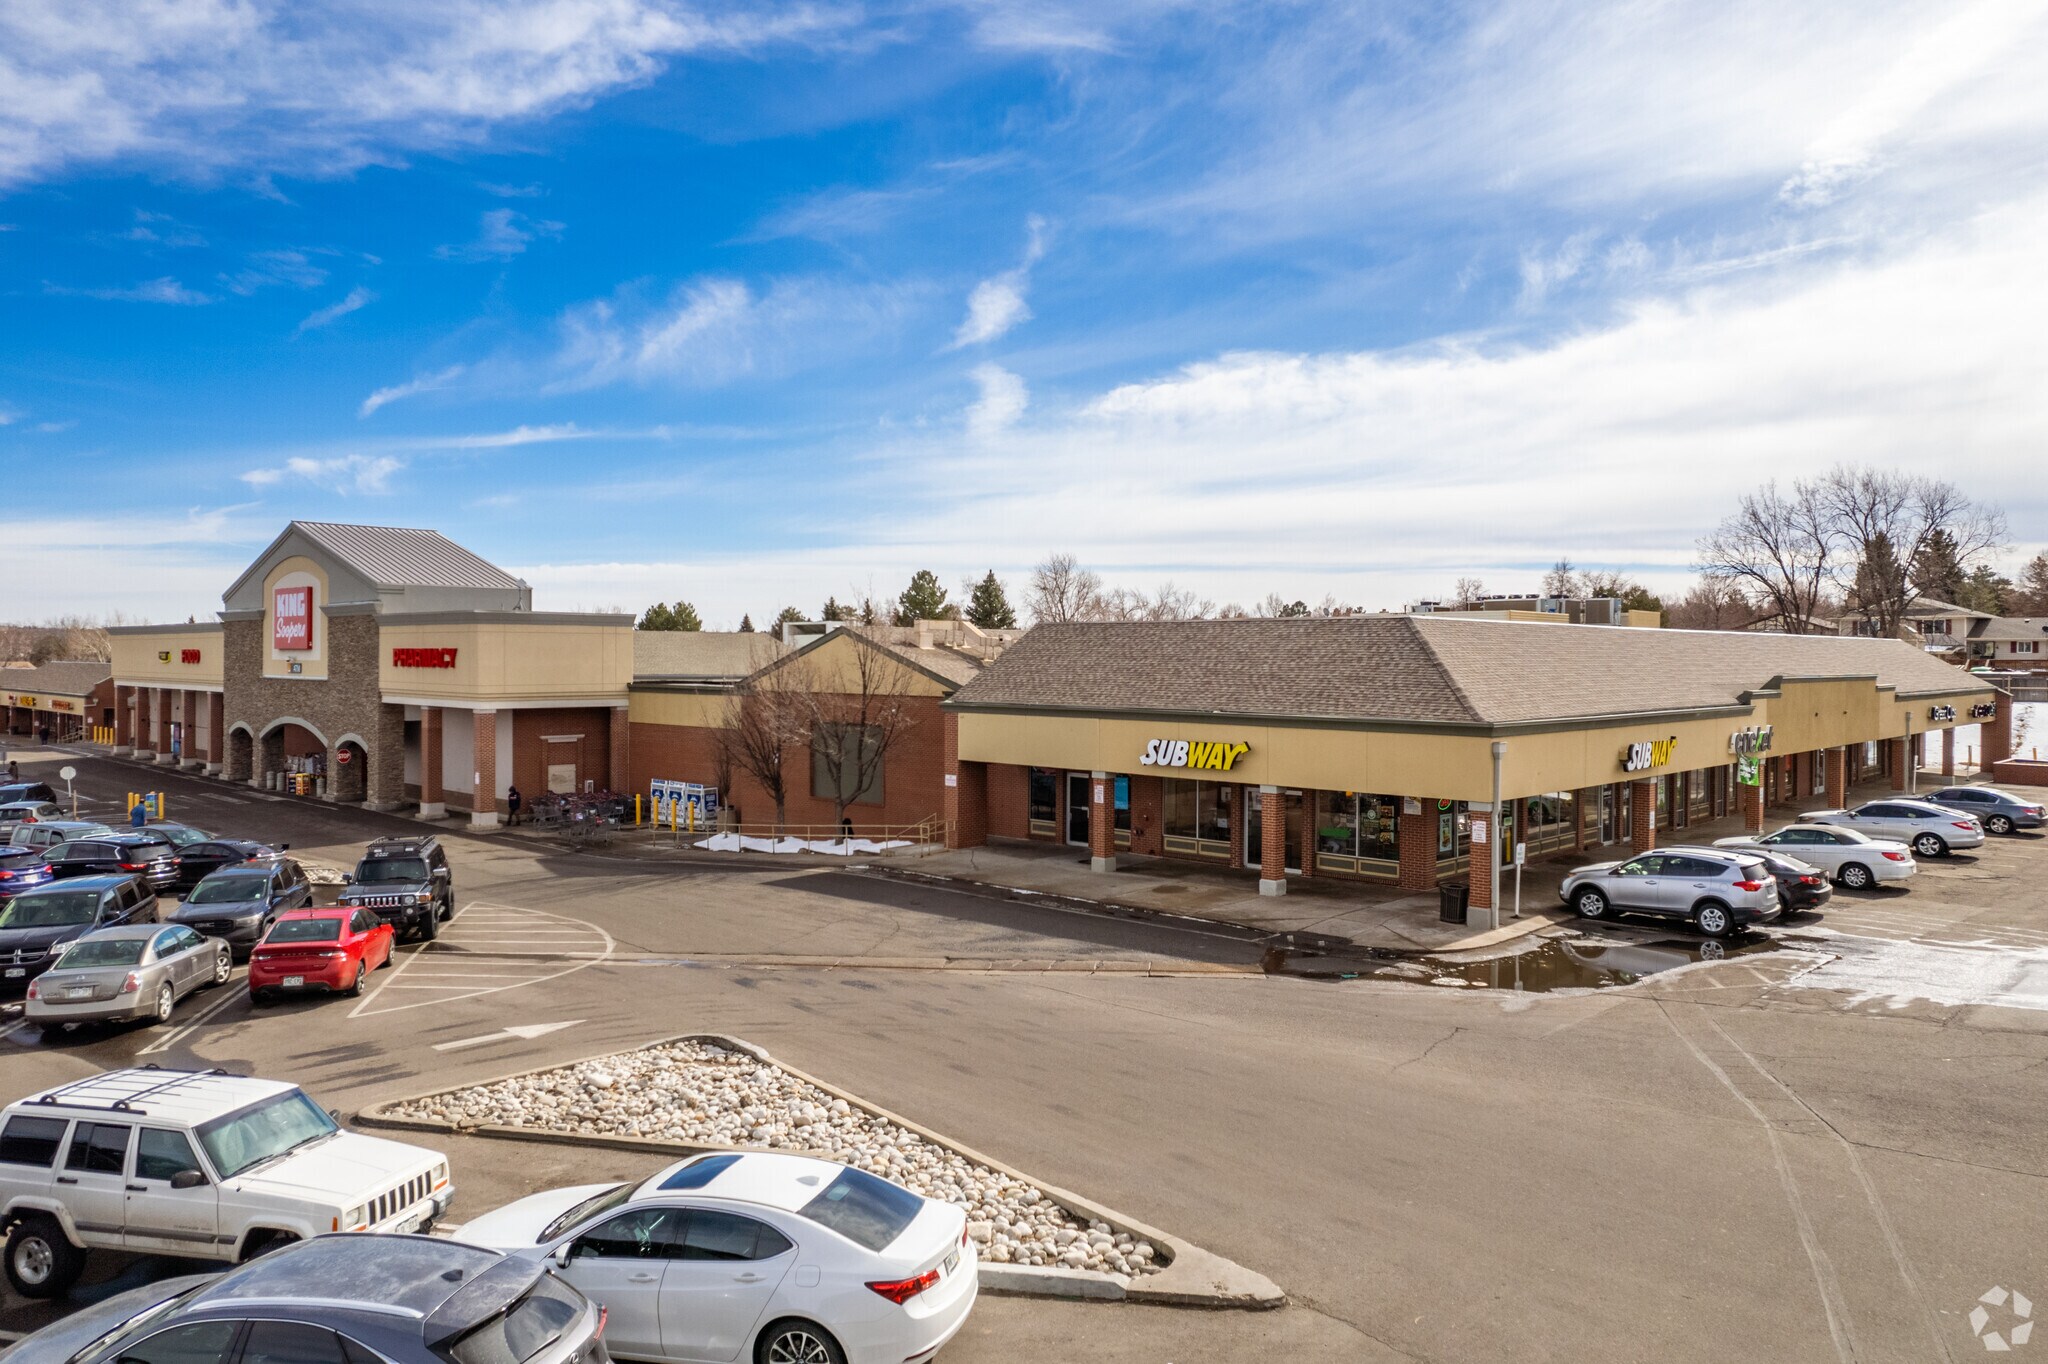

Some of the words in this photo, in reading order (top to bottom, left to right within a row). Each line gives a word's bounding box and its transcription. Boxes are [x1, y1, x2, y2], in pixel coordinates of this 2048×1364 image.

[277, 592, 305, 617] KING
[276, 617, 305, 643] Soopers
[393, 648, 458, 669] PHARMACY
[1731, 725, 1773, 754] cricket
[1139, 739, 1251, 771] SUBWAY
[1625, 737, 1678, 772] SUBWAY
